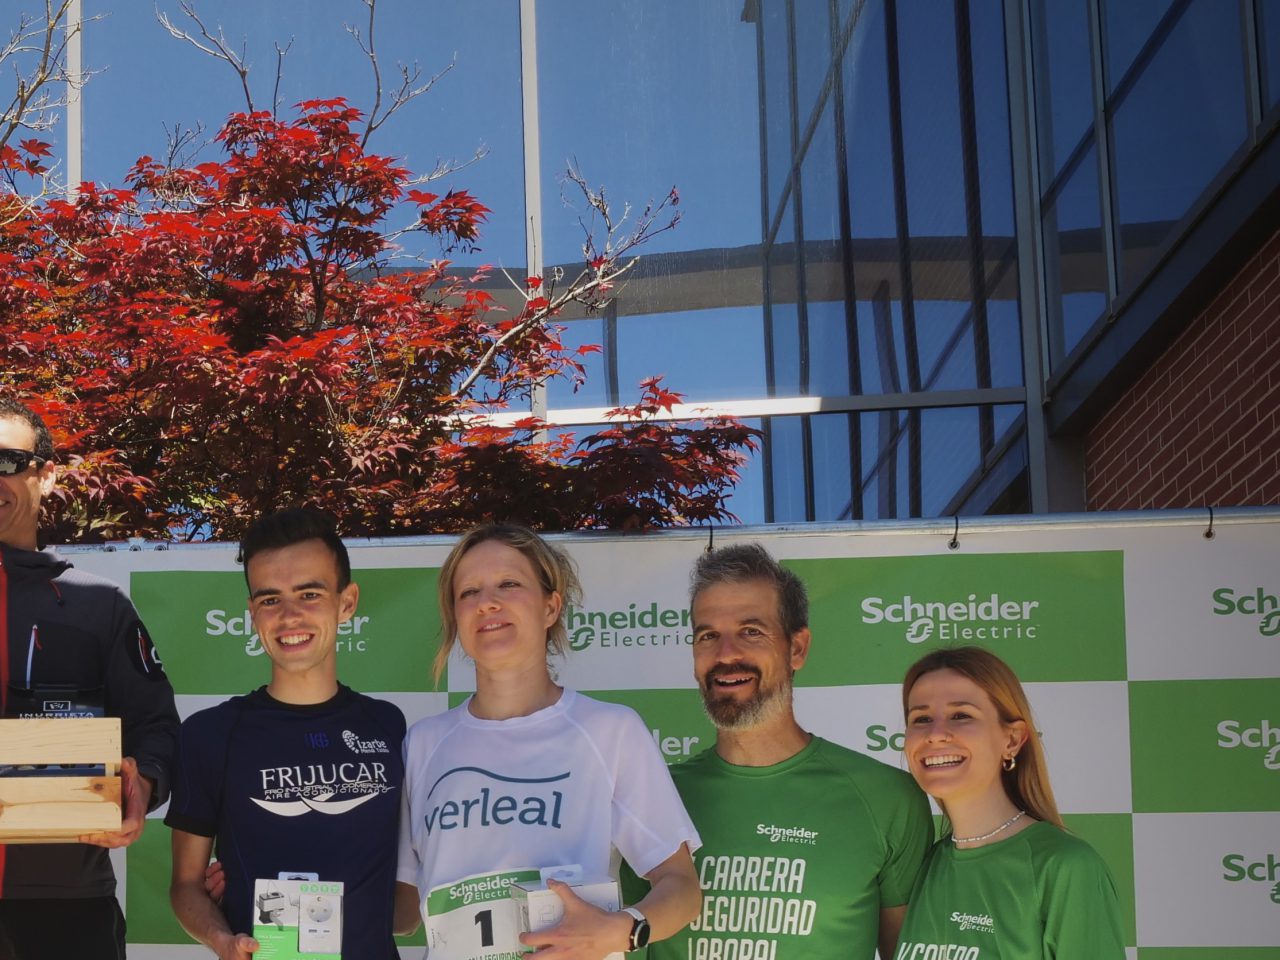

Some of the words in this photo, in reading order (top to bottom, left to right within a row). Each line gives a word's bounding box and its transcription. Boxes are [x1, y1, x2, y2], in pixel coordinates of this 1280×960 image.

[567, 602, 692, 630] hneider
[861, 593, 1040, 624] Schneider
[939, 623, 1037, 640] Electric
[259, 762, 388, 790] FRIJUCAR
[424, 787, 563, 837] verleal
[756, 823, 819, 840] Schneider
[449, 875, 518, 900] Schneider
[699, 855, 807, 894] CARRERA
[475, 889, 513, 901] Electri
[474, 909, 494, 948] 1
[949, 911, 994, 927] Schneide
